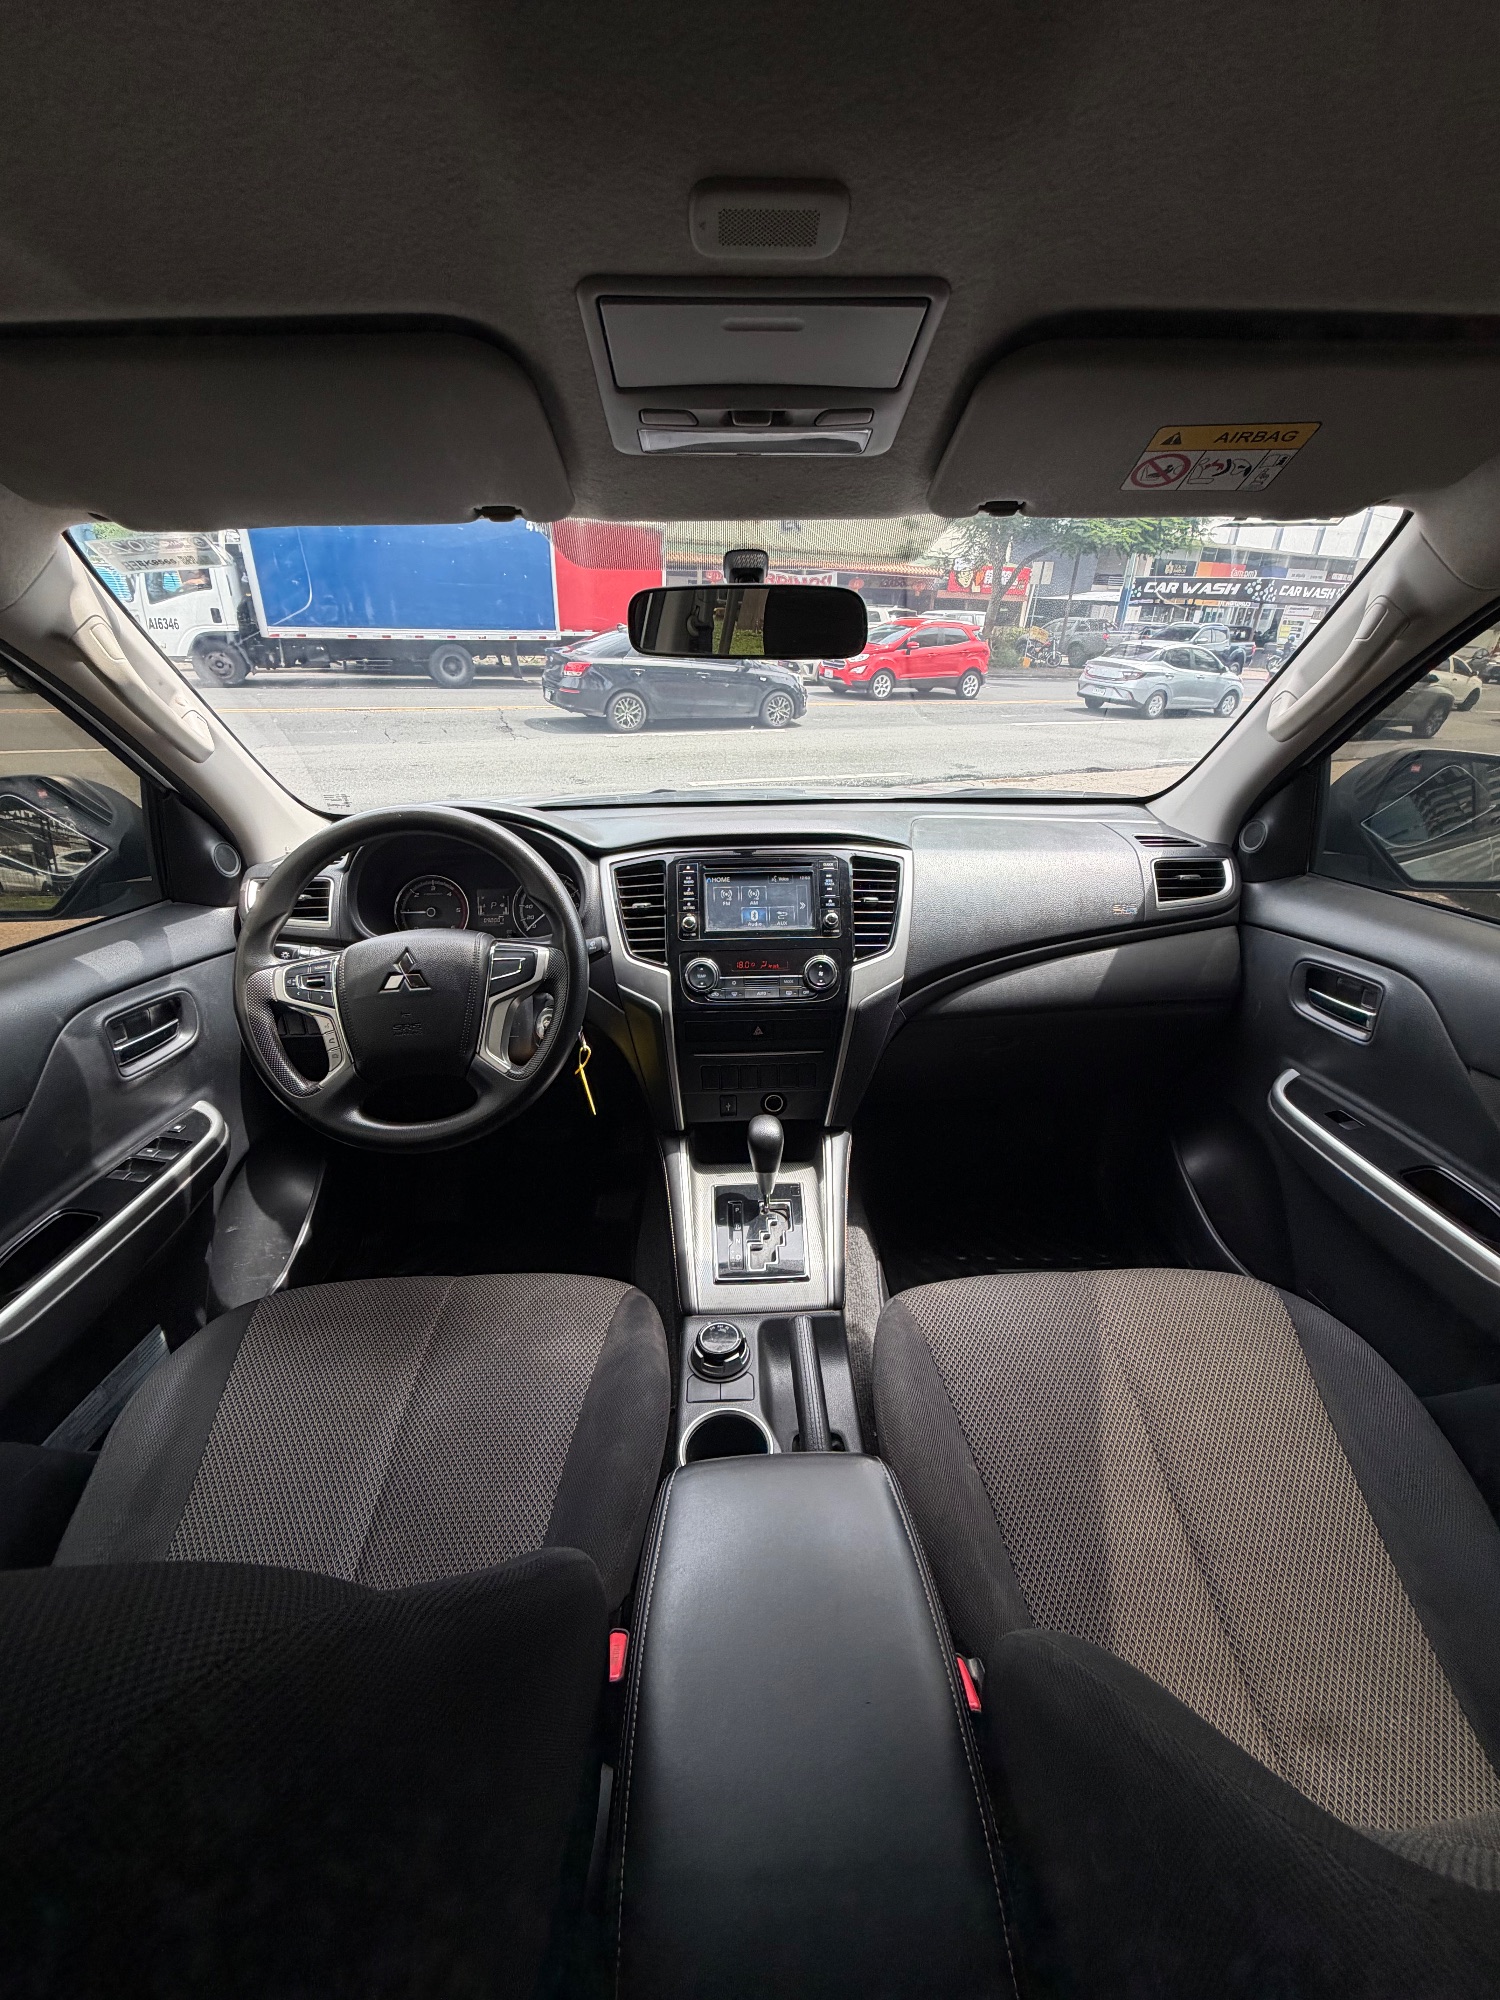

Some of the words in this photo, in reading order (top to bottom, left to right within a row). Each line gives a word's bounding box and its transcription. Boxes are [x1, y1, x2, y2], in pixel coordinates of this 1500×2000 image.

[1213, 430, 1300, 443] AIRBAG
[1143, 581, 1180, 594] CAR
[1182, 582, 1242, 595] WASH
[1278, 585, 1303, 597] CAR
[1302, 586, 1337, 599] WASH
[148, 617, 180, 630] AI6346
